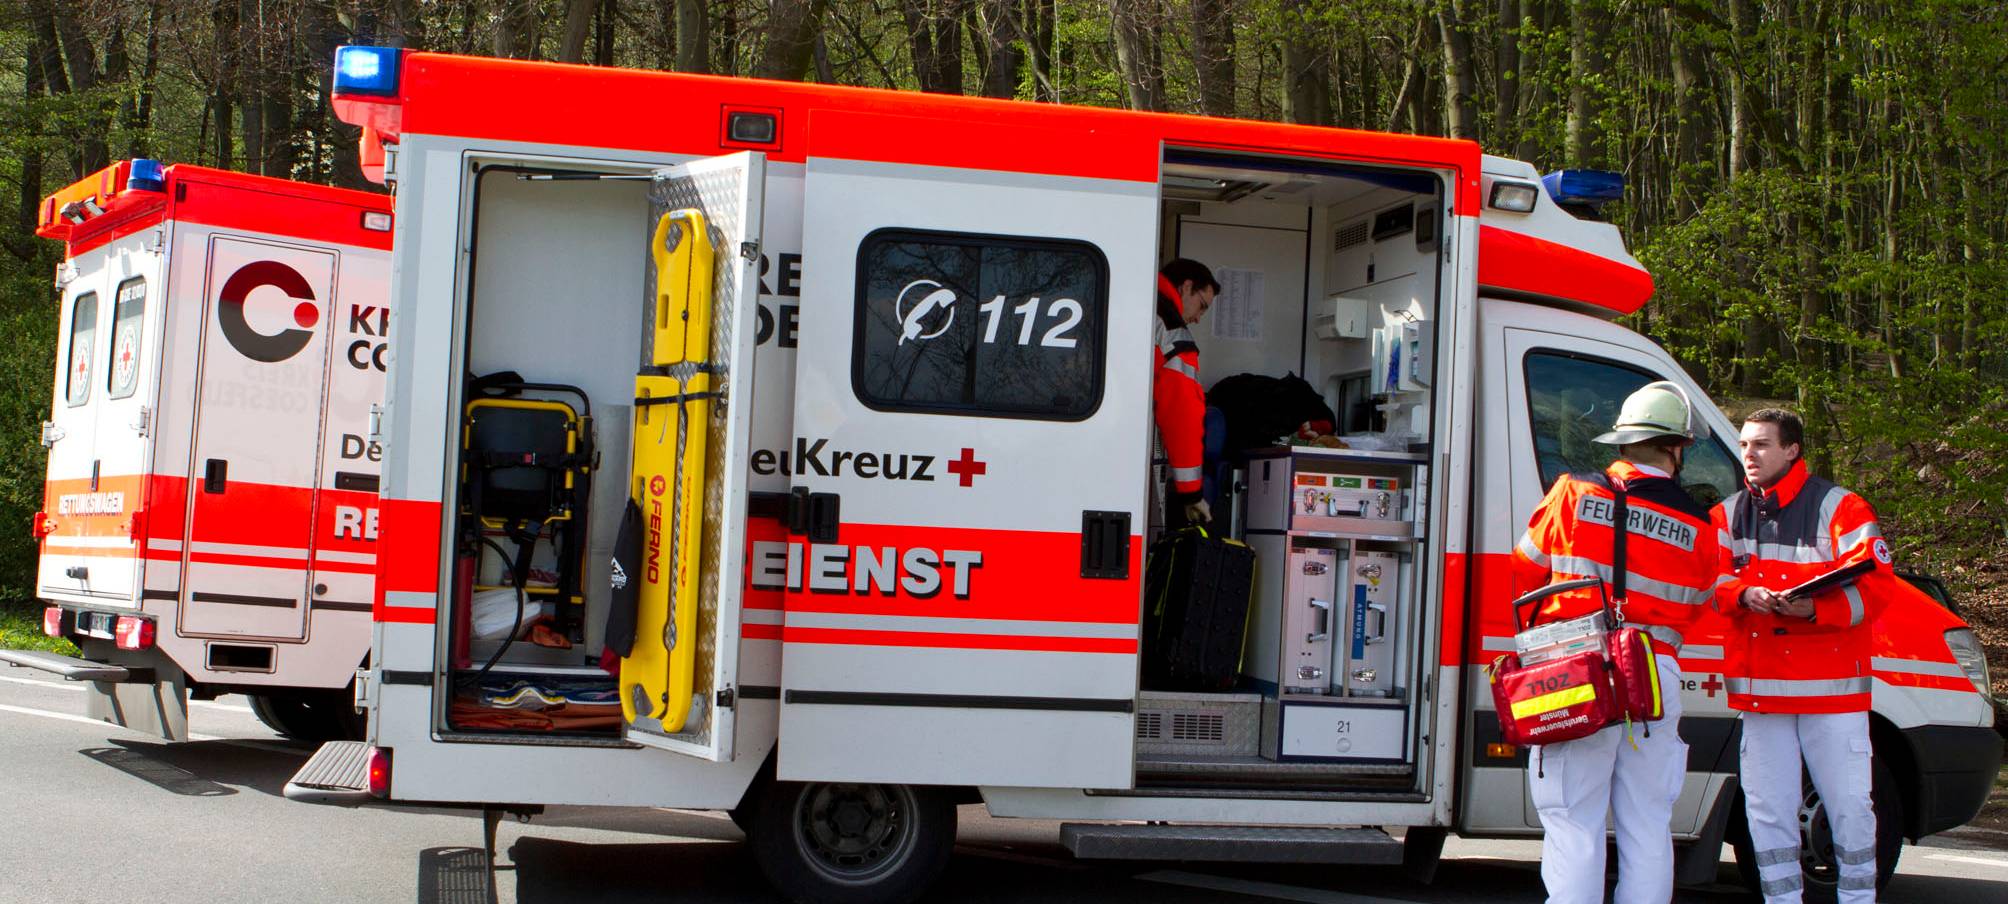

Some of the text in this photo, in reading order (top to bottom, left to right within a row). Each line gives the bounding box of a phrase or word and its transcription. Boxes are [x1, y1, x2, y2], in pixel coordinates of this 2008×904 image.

[979, 295, 1084, 349] 112
[795, 437, 936, 482] Kreuz
[58, 491, 125, 515] RETTUNGSWAGEN
[1582, 499, 1691, 546] FEURWEHR
[647, 498, 662, 585] FERNO
[1355, 603, 1363, 639] ATMUNG
[1526, 672, 1571, 695] ZOLL
[1337, 720, 1351, 734] 21
[1529, 714, 1589, 736] Berufsfeuerwehr
[1540, 708, 1570, 722] Münster
